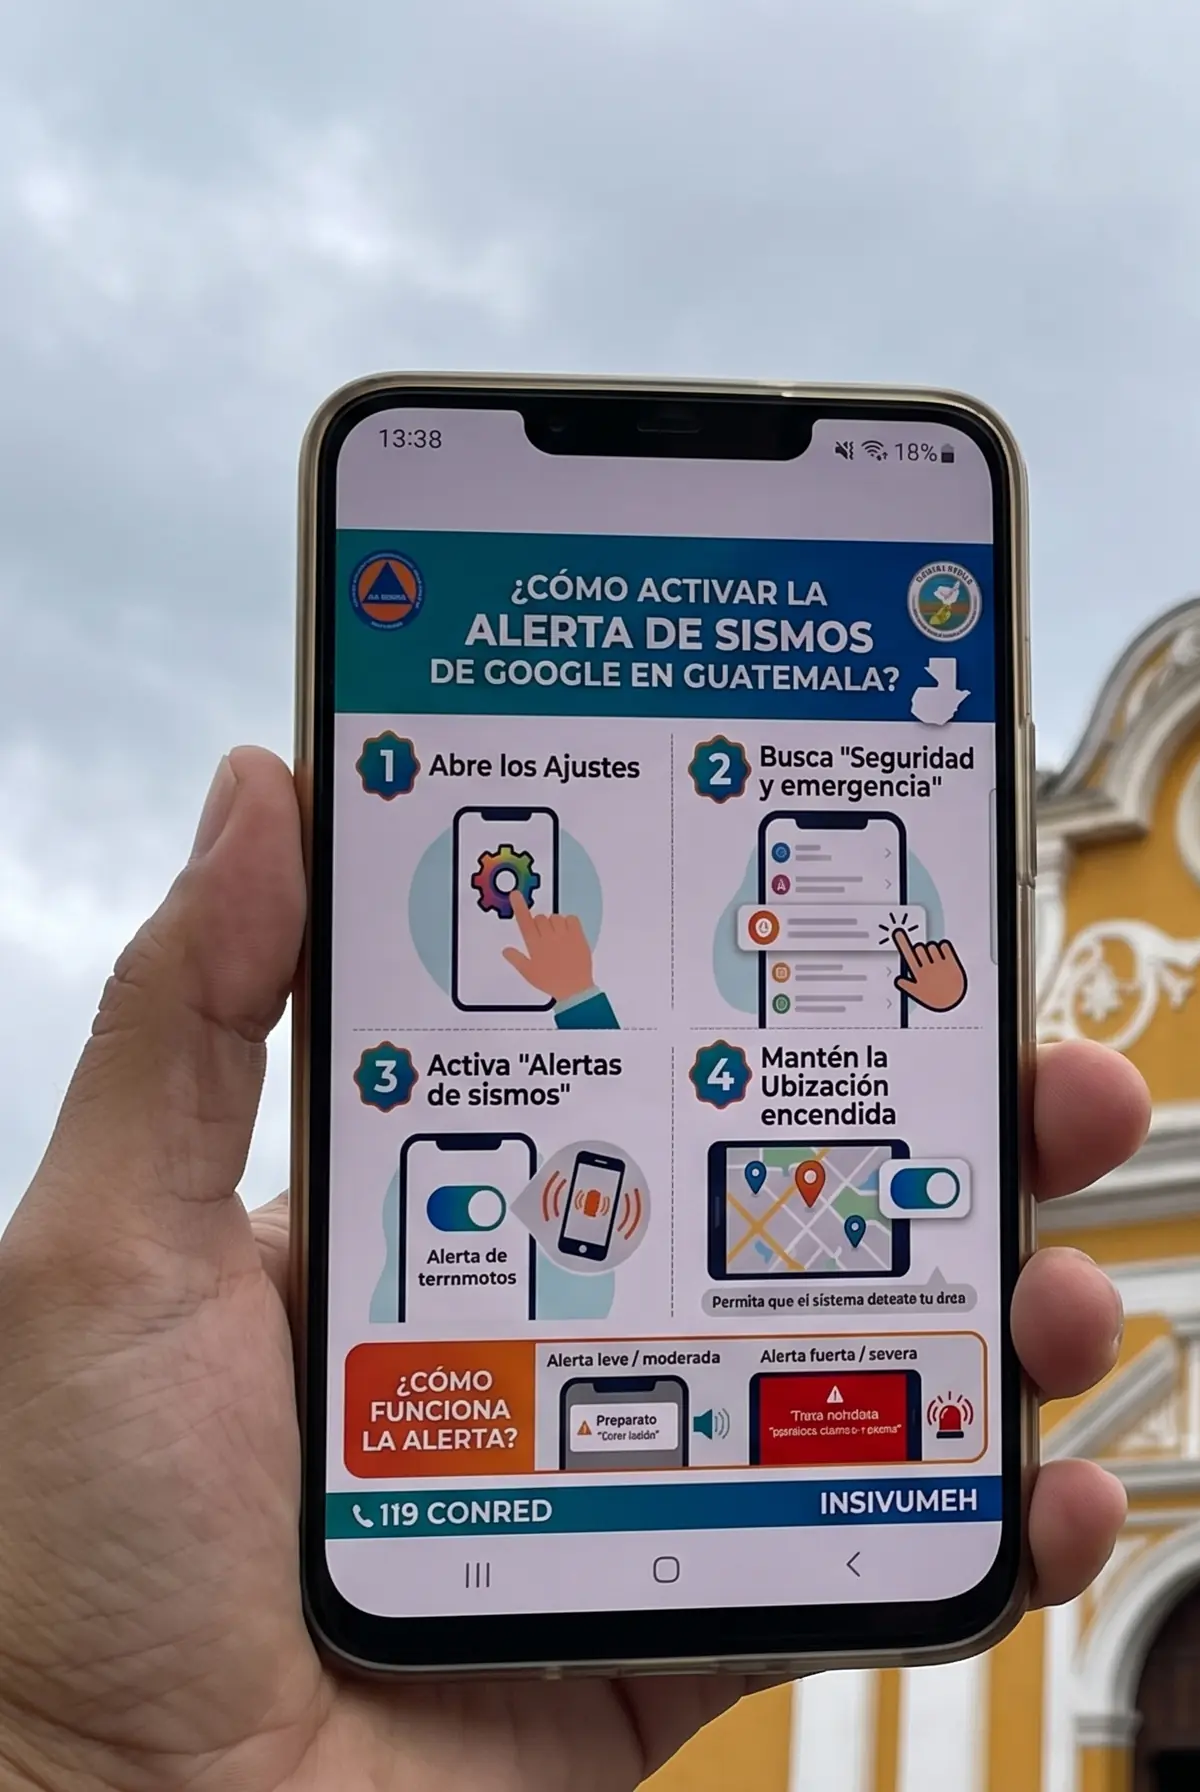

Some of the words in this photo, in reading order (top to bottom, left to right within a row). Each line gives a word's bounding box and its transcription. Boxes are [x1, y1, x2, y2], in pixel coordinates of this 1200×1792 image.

[379, 428, 442, 449] 13:38
[895, 443, 938, 464] 18%
[511, 570, 628, 606] ¿CÓMO
[637, 578, 777, 605] ACTIVAR
[787, 580, 827, 606] LA
[465, 613, 633, 649] ALERTA
[646, 617, 702, 651] DE
[715, 620, 874, 654] SISMOS
[430, 659, 474, 685] DE
[484, 660, 621, 688] GOOGLE
[631, 663, 673, 688] EN
[683, 663, 900, 692] GUATEMALA?
[380, 749, 394, 782] 1
[428, 754, 492, 777] Abre
[501, 753, 537, 777] los
[544, 754, 640, 784] Ajustes
[708, 752, 732, 785] 2
[760, 745, 833, 768] Busca
[841, 745, 974, 774] "Seguridad
[759, 778, 774, 801] y
[781, 774, 942, 802] emergencia"
[427, 1052, 510, 1076] Activa
[519, 1053, 622, 1076] "Alertas
[761, 1045, 858, 1069] Mantén
[867, 1046, 888, 1068] la
[373, 1060, 398, 1093] 3
[707, 1058, 735, 1091] 4
[761, 1073, 889, 1097] Ubización
[427, 1083, 460, 1106] de
[468, 1082, 570, 1106] sismos"
[761, 1102, 896, 1126] encendida
[427, 1248, 480, 1264] Alerta
[485, 1247, 508, 1263] de
[712, 1294, 765, 1308] Permita
[768, 1297, 794, 1310] que
[919, 1293, 934, 1305] tu
[547, 1353, 593, 1367] Alerta
[597, 1352, 628, 1366] leve
[632, 1350, 640, 1367] /
[643, 1350, 721, 1365] moderada
[760, 1349, 806, 1363] Alerta
[810, 1348, 856, 1362] fuerta
[859, 1345, 866, 1363] /
[869, 1349, 918, 1361] severa
[397, 1366, 493, 1397] ¿CÓMO
[371, 1399, 511, 1422] FUNCIONA
[596, 1414, 657, 1428] Preparato
[362, 1431, 396, 1451] LA
[402, 1427, 518, 1450] ALERTA?
[380, 1503, 419, 1526] 119
[427, 1499, 552, 1524] CONRED
[821, 1488, 977, 1515] INSIVUMEH
